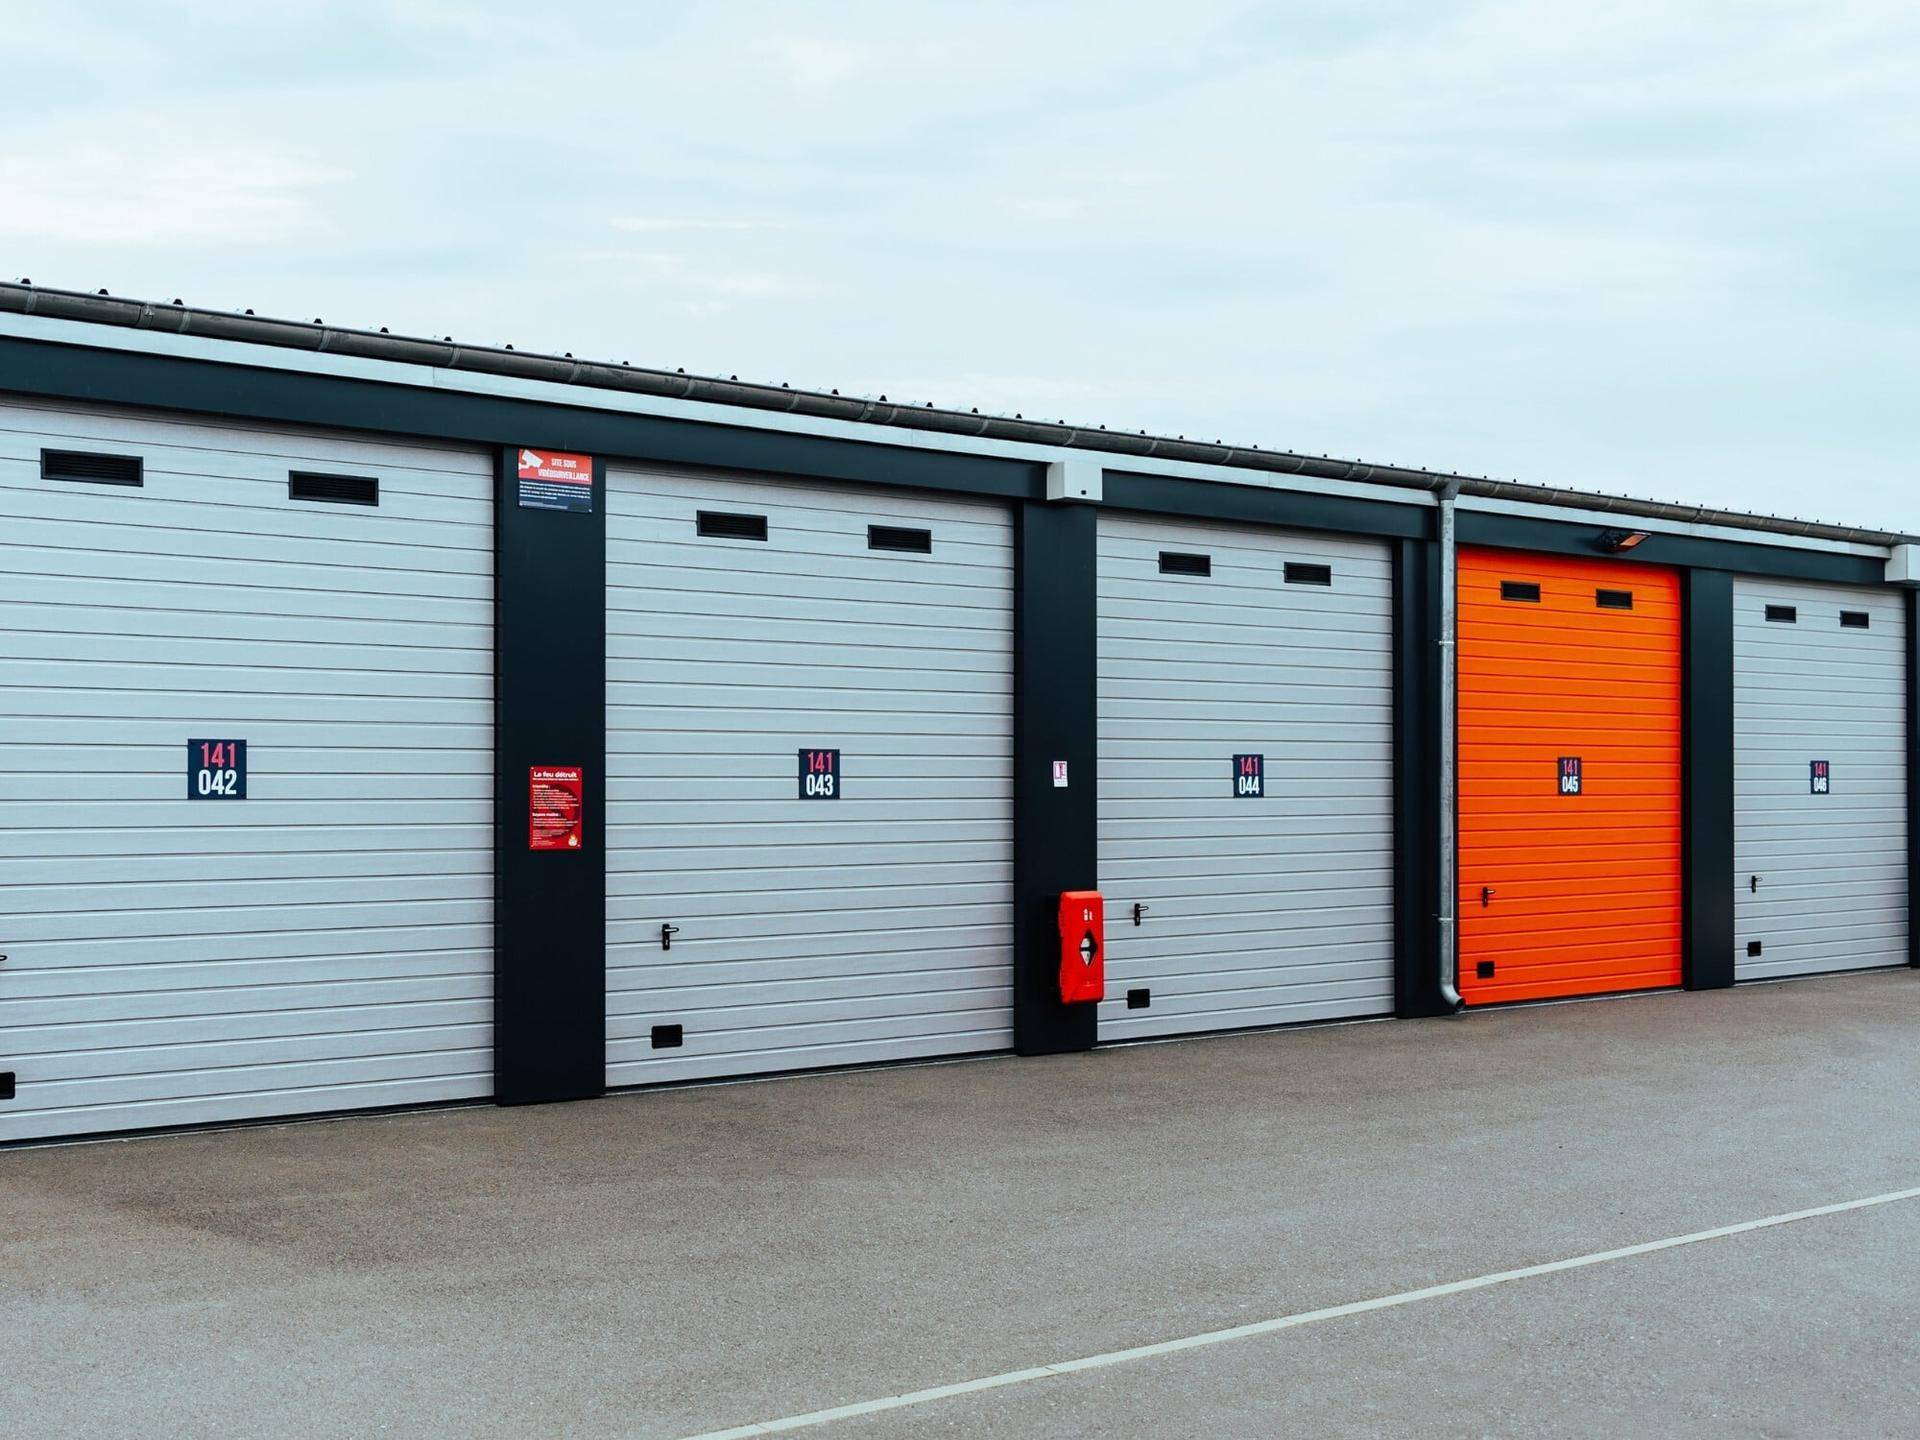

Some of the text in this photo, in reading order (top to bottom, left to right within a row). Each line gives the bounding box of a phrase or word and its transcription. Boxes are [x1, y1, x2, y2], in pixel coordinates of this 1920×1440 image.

[200, 742, 236, 768] 141
[807, 751, 832, 773] 141
[1240, 756, 1259, 775] 141
[1562, 759, 1578, 775] 141
[1814, 762, 1827, 777] 141
[198, 769, 237, 795] 042
[806, 774, 834, 796] 043
[1239, 775, 1260, 795] 044
[1562, 775, 1579, 793] 045
